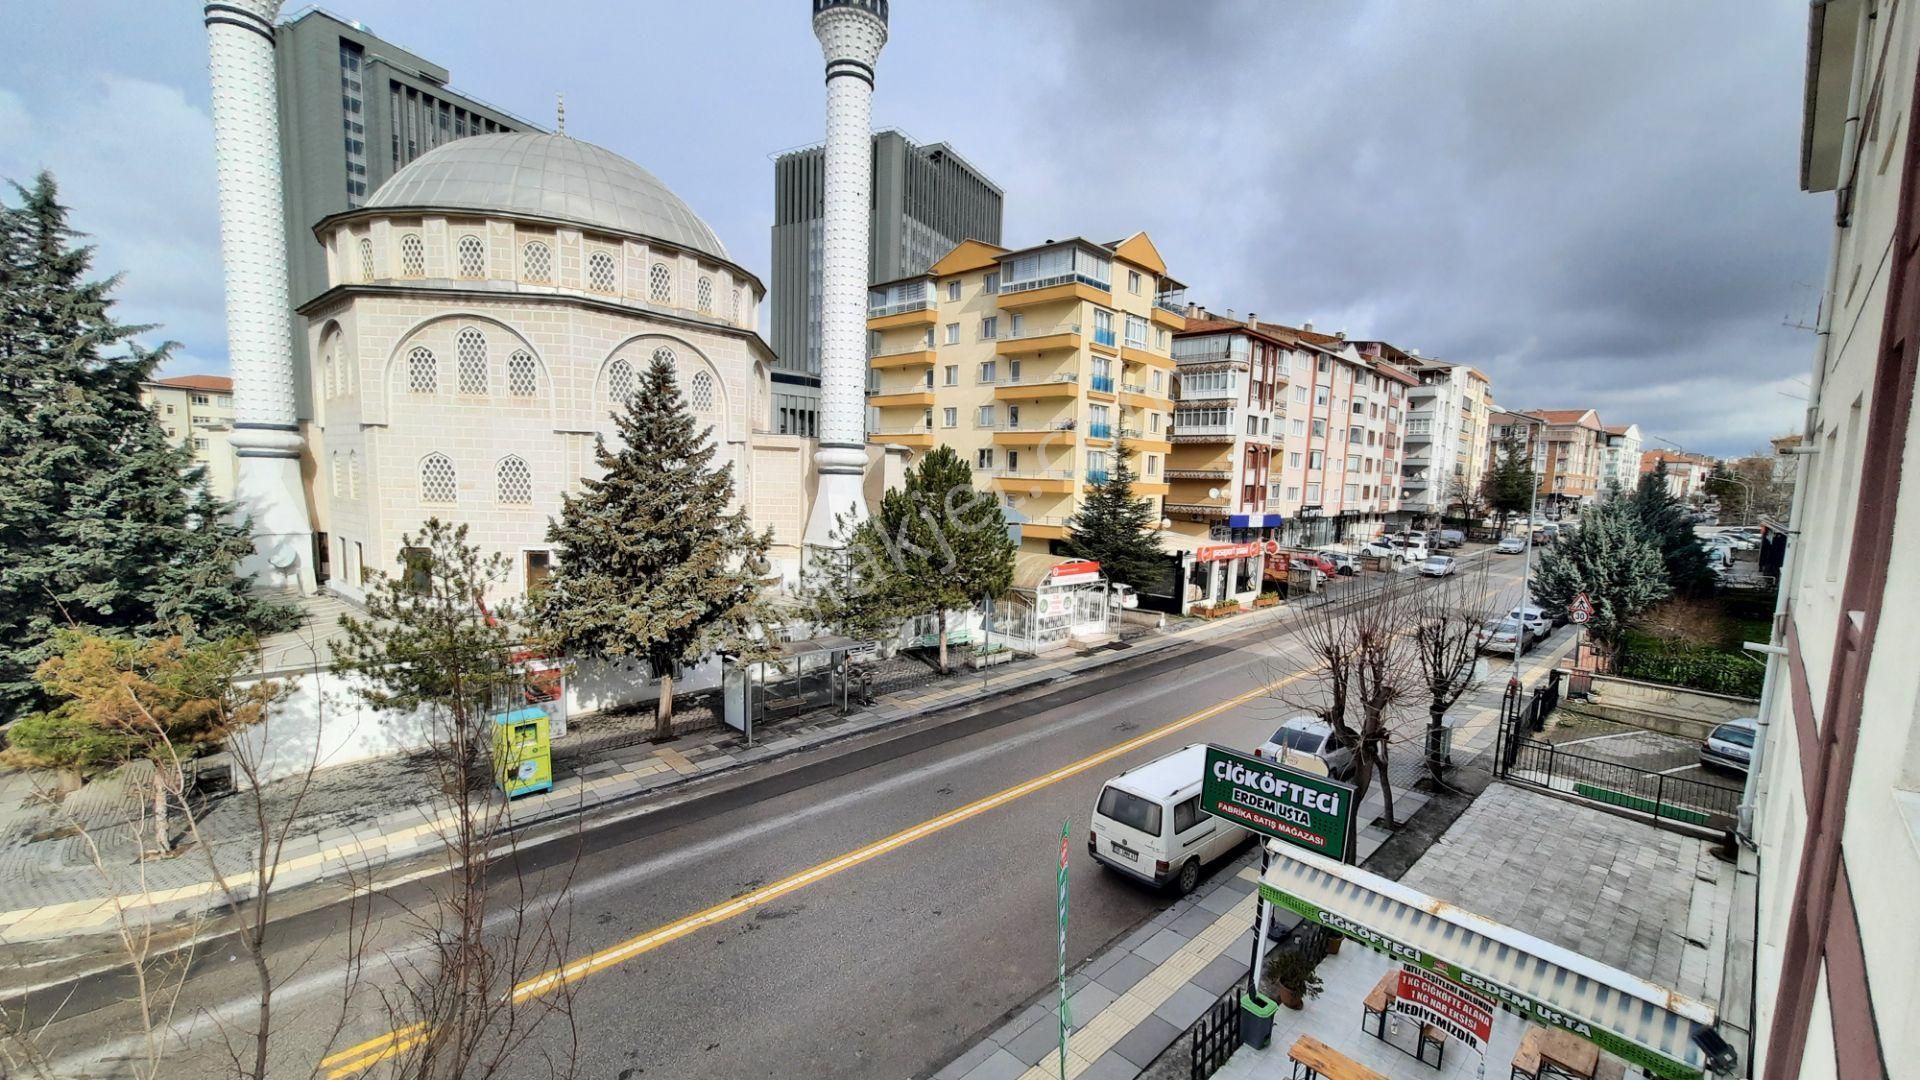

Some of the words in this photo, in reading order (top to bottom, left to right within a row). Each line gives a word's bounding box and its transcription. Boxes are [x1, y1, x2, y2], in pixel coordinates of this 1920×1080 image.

[1575, 612, 1585, 620] 30
[1213, 760, 1340, 816] ÇİĞKÖFTECİ
[1234, 790, 1276, 814] ERDEM
[1277, 806, 1309, 826] USTA
[1218, 802, 1252, 820] FABRİKA
[1253, 813, 1276, 829] SATIŞ
[1278, 823, 1324, 846] MAĞAZASI
[1402, 975, 1406, 984] 1
[1407, 976, 1420, 988] KG
[1462, 1004, 1490, 1027] ALANA
[1403, 963, 1421, 976] TATLI
[1458, 989, 1494, 1015] BULUNUR
[1411, 990, 1416, 998] 1
[1417, 991, 1429, 1004] KG
[1430, 998, 1448, 1014] NAR
[1460, 972, 1532, 1011] ERDEM
[1536, 1004, 1593, 1039] USTA
[1396, 999, 1477, 1049] HEDİYEMİZDİR
